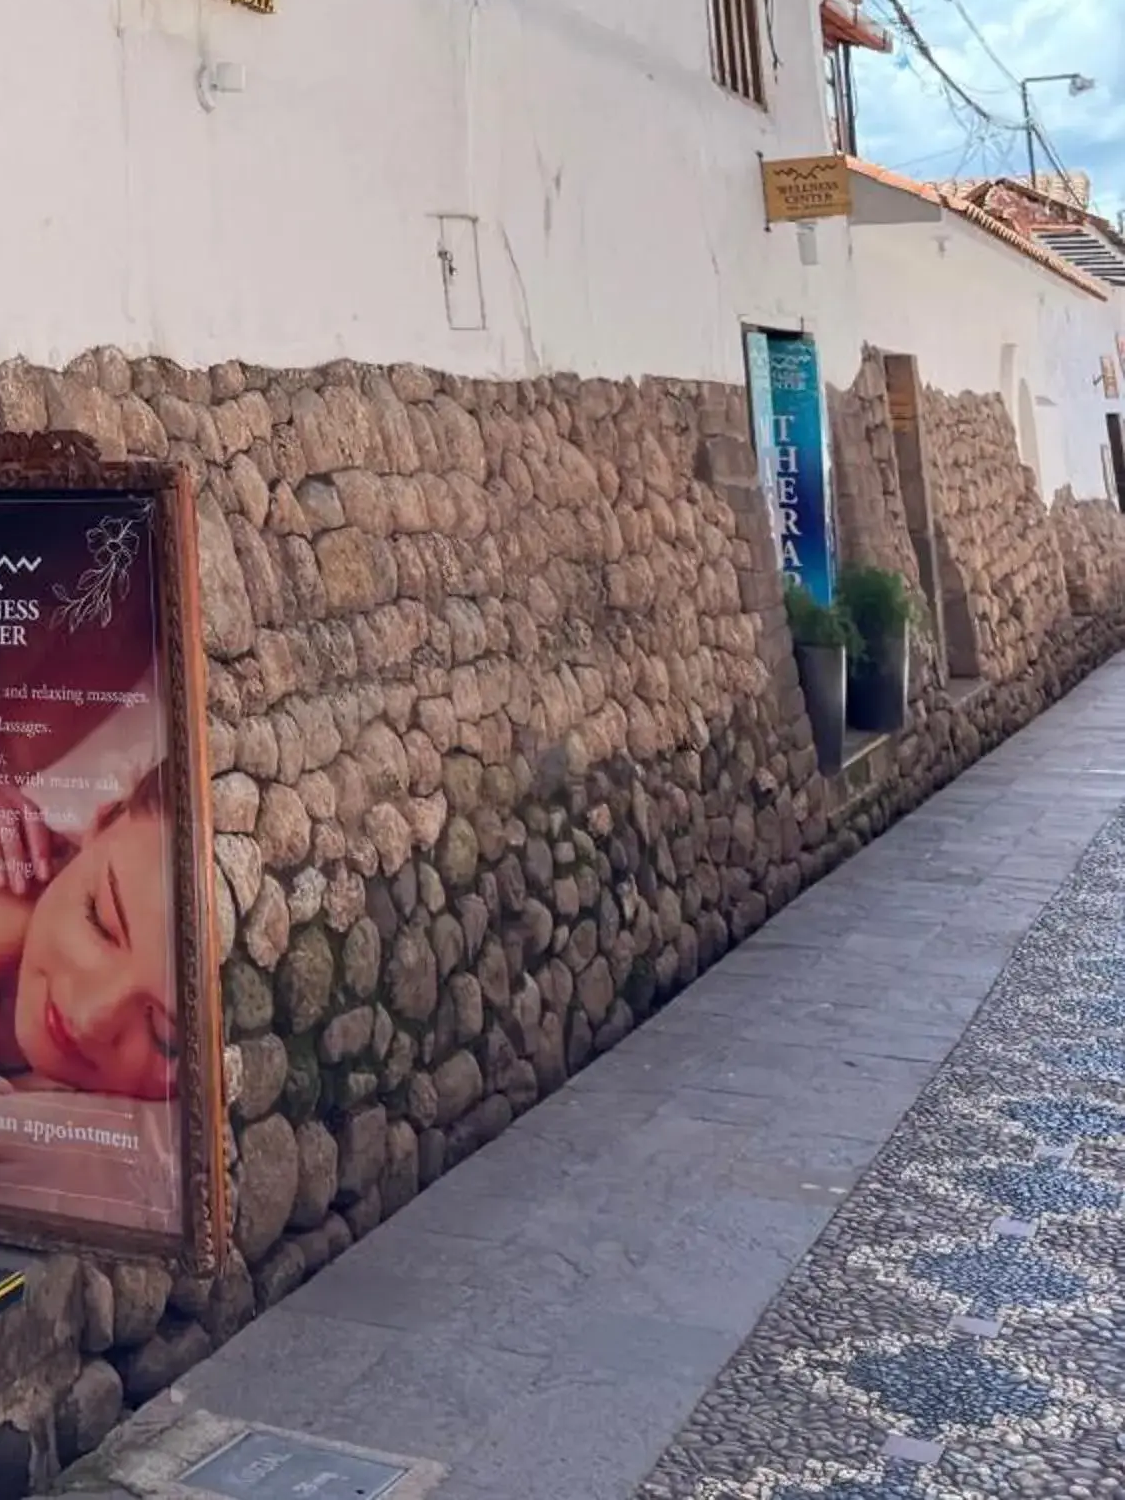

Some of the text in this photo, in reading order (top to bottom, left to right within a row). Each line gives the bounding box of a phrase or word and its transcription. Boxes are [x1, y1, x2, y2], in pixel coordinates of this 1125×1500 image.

[3, 684, 28, 700] and
[31, 685, 84, 705] relaxing
[14, 771, 45, 790] with
[23, 1116, 140, 1152] appointment
